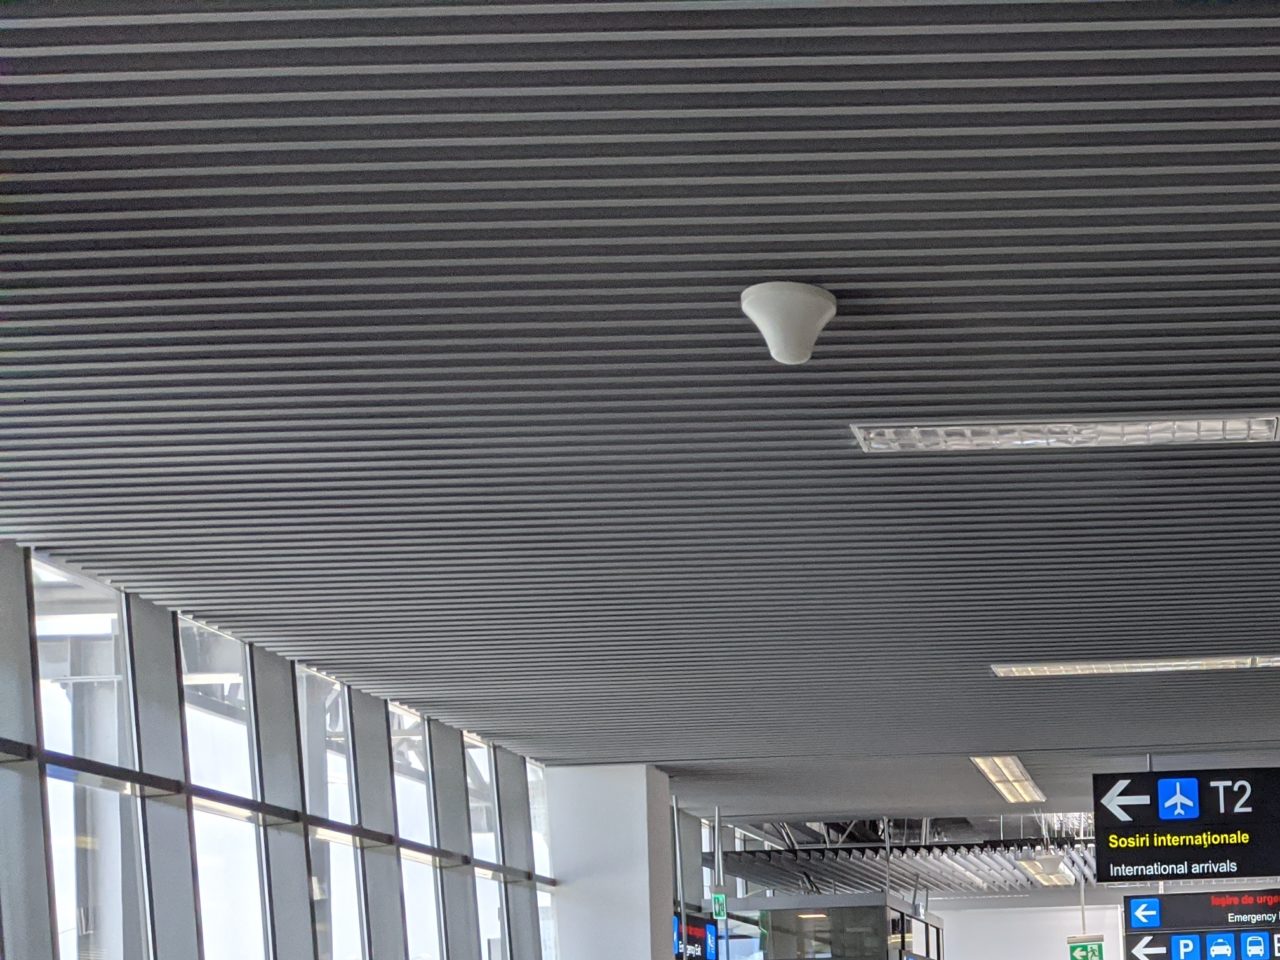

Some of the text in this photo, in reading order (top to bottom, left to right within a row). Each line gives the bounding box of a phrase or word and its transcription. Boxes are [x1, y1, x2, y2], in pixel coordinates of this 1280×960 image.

[1209, 780, 1253, 814] T2
[1108, 833, 1150, 848] Sosiri
[1109, 860, 1238, 877] International arrivals
[1228, 912, 1277, 924] Emergency
